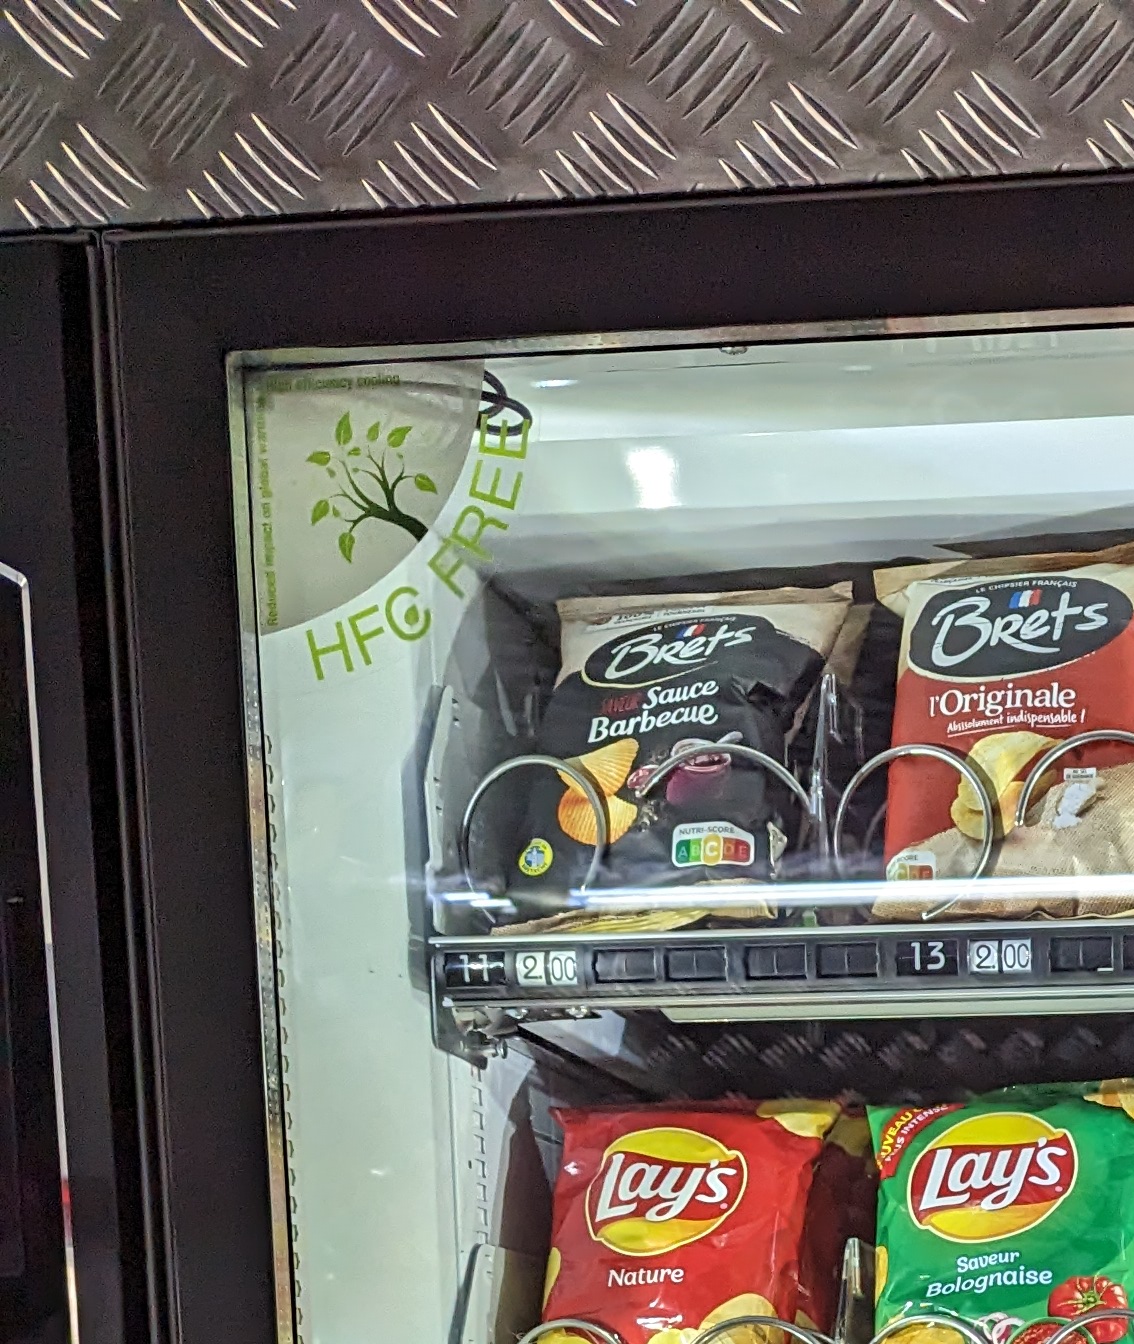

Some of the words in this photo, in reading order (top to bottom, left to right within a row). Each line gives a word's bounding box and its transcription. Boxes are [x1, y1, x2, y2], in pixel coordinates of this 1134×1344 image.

[305, 586, 432, 681] HFC
[428, 414, 531, 600] FREE
[646, 679, 720, 709] Sauce
[929, 682, 1077, 717] l'Originale
[587, 704, 719, 744] Barbecue
[460, 955, 489, 981] 11
[911, 942, 946, 970] 13
[594, 1152, 738, 1223] Lay's
[919, 1136, 1068, 1212] Lay's
[956, 1249, 1021, 1273] Saveur
[607, 1267, 685, 1288] Nature
[925, 1268, 1053, 1298] Bolognaise
